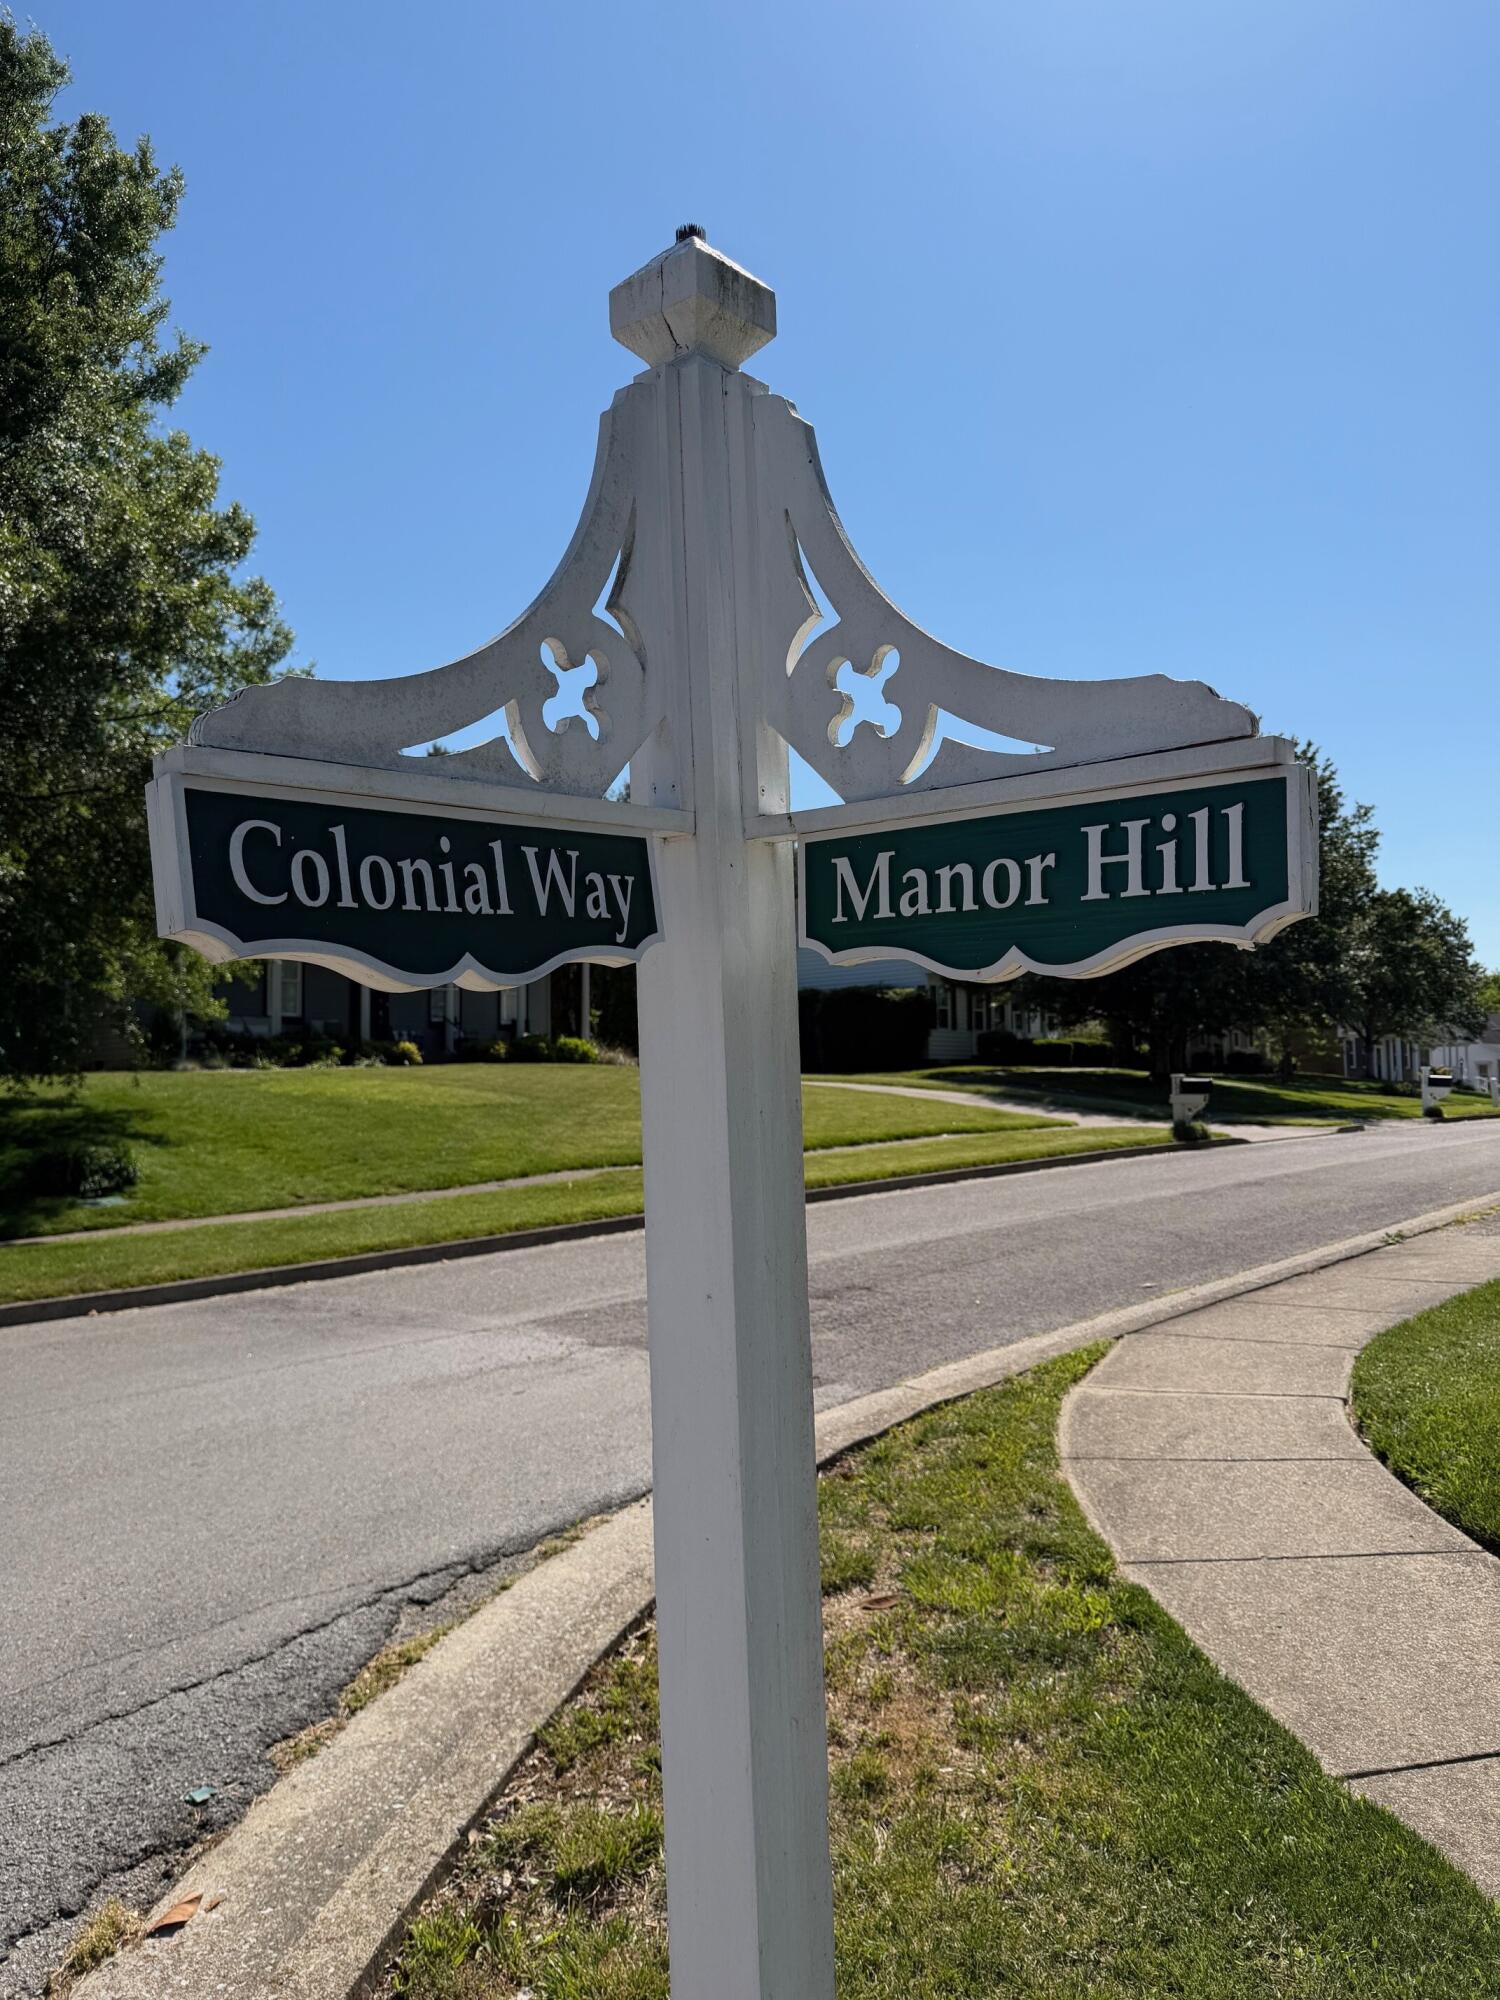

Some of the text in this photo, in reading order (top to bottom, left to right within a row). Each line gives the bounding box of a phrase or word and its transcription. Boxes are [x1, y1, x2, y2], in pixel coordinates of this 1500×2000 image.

[229, 819, 635, 943] Colonial Way
[831, 801, 1251, 924] Manor Hill
